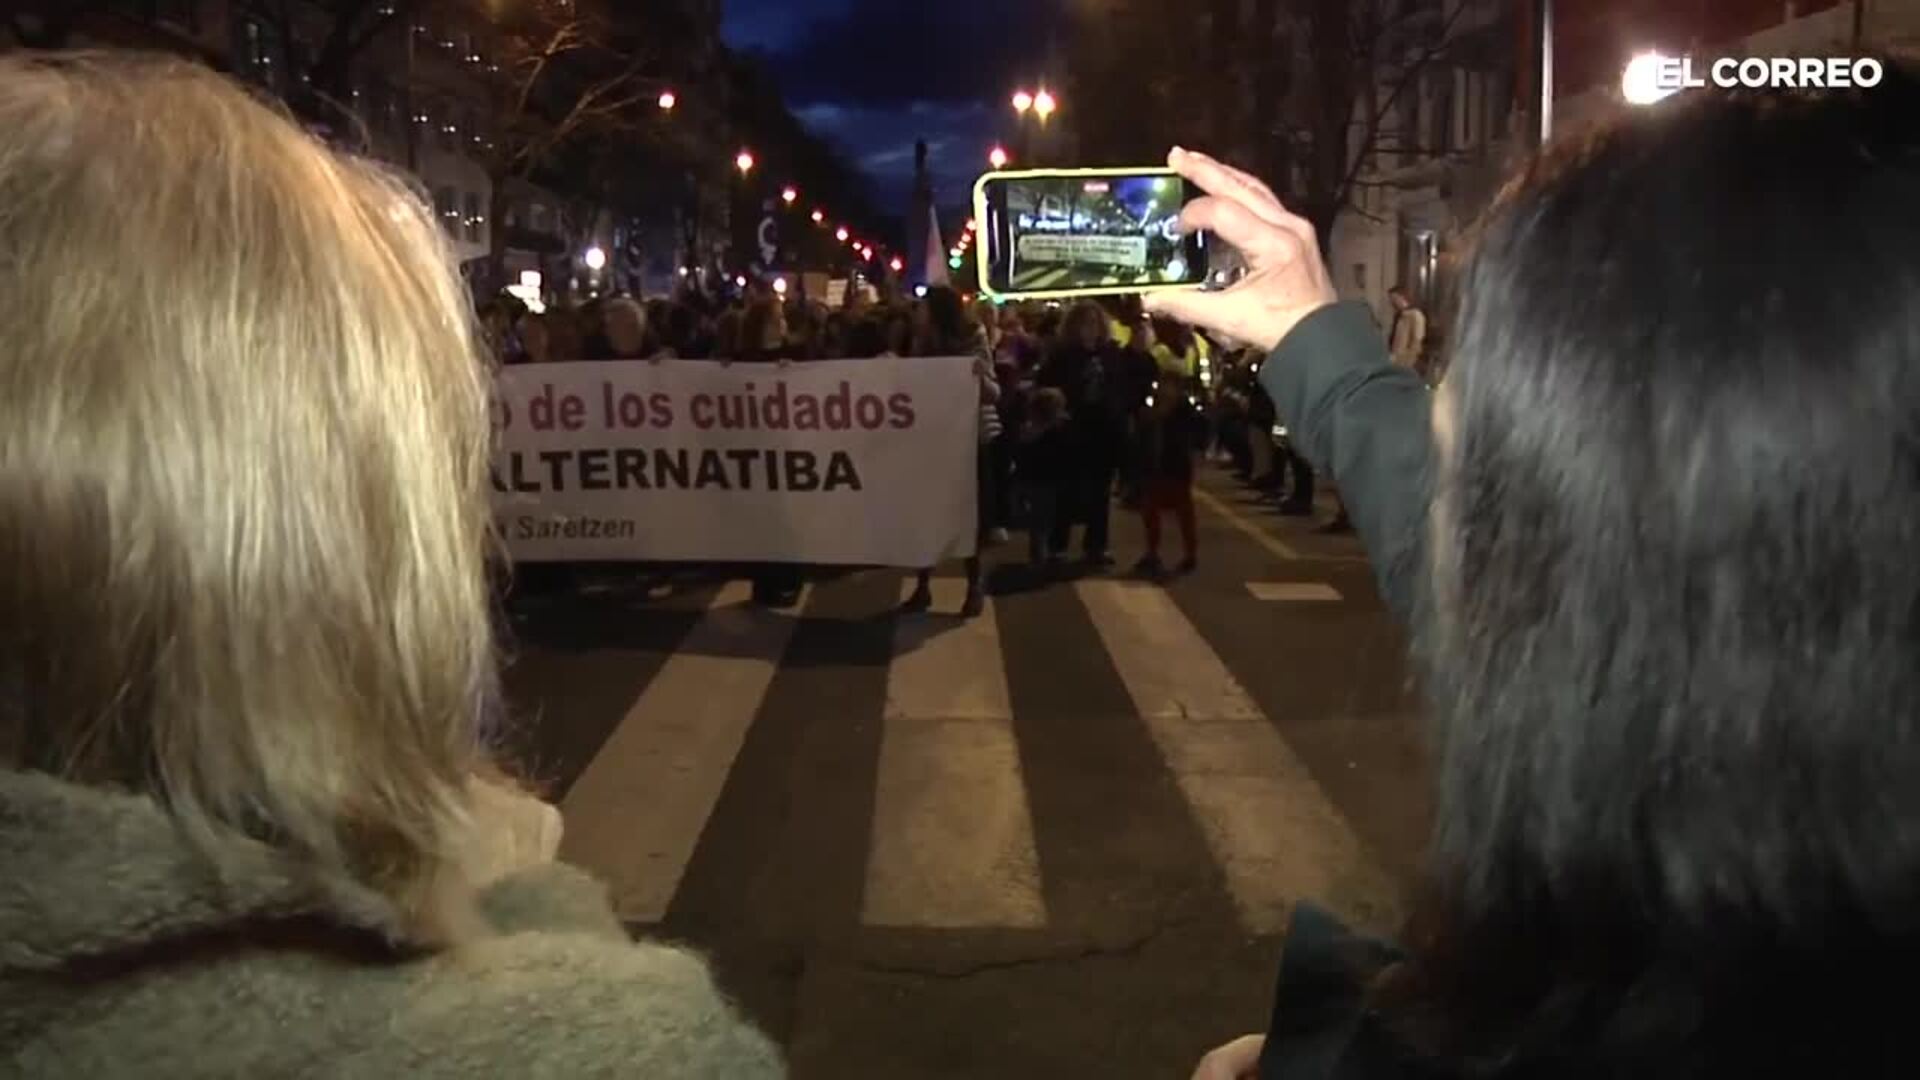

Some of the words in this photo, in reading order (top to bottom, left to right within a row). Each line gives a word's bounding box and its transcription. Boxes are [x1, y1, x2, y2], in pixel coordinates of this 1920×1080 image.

[529, 383, 586, 430] de
[602, 381, 673, 430] los
[690, 380, 916, 431] cuidados
[517, 514, 636, 541] Saretzen
